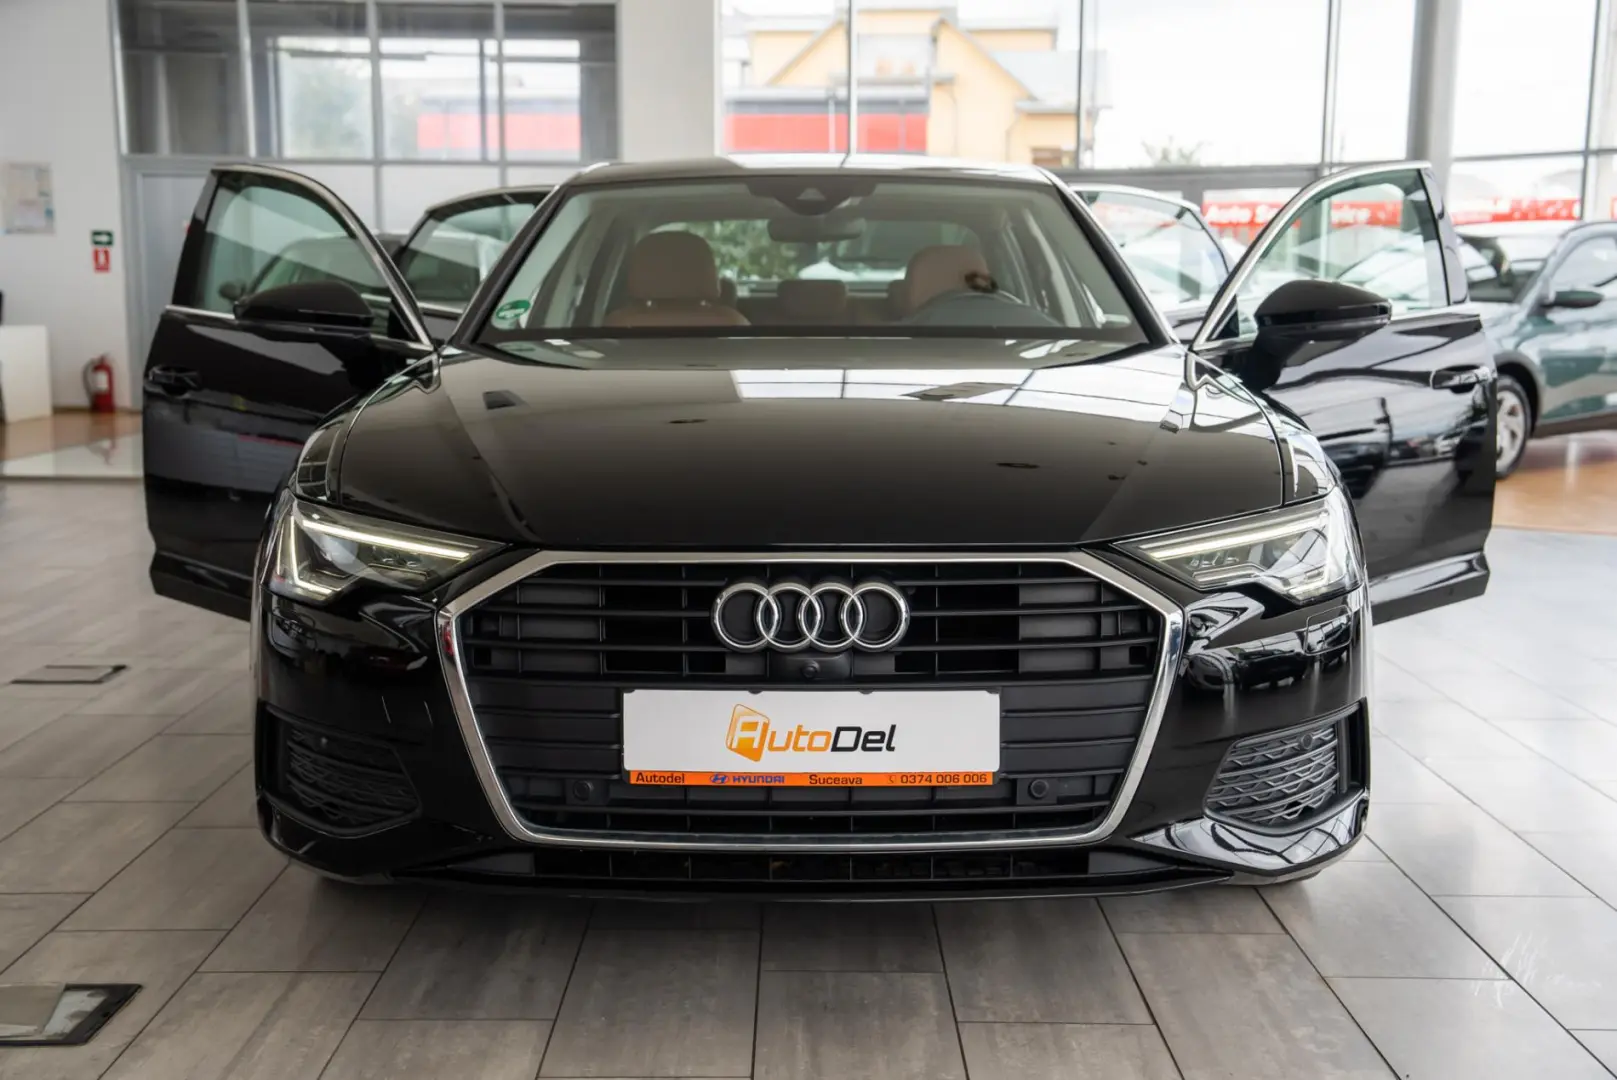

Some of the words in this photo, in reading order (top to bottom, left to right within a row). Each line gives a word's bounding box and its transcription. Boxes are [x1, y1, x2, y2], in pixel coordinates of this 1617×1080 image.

[729, 712, 897, 754] AutoDel
[635, 772, 685, 784] Autodel
[732, 776, 785, 784] HYUNDAI
[809, 774, 863, 785] Suceava
[900, 774, 932, 784] 0374
[936, 774, 960, 784] 006
[963, 774, 987, 784] 006
